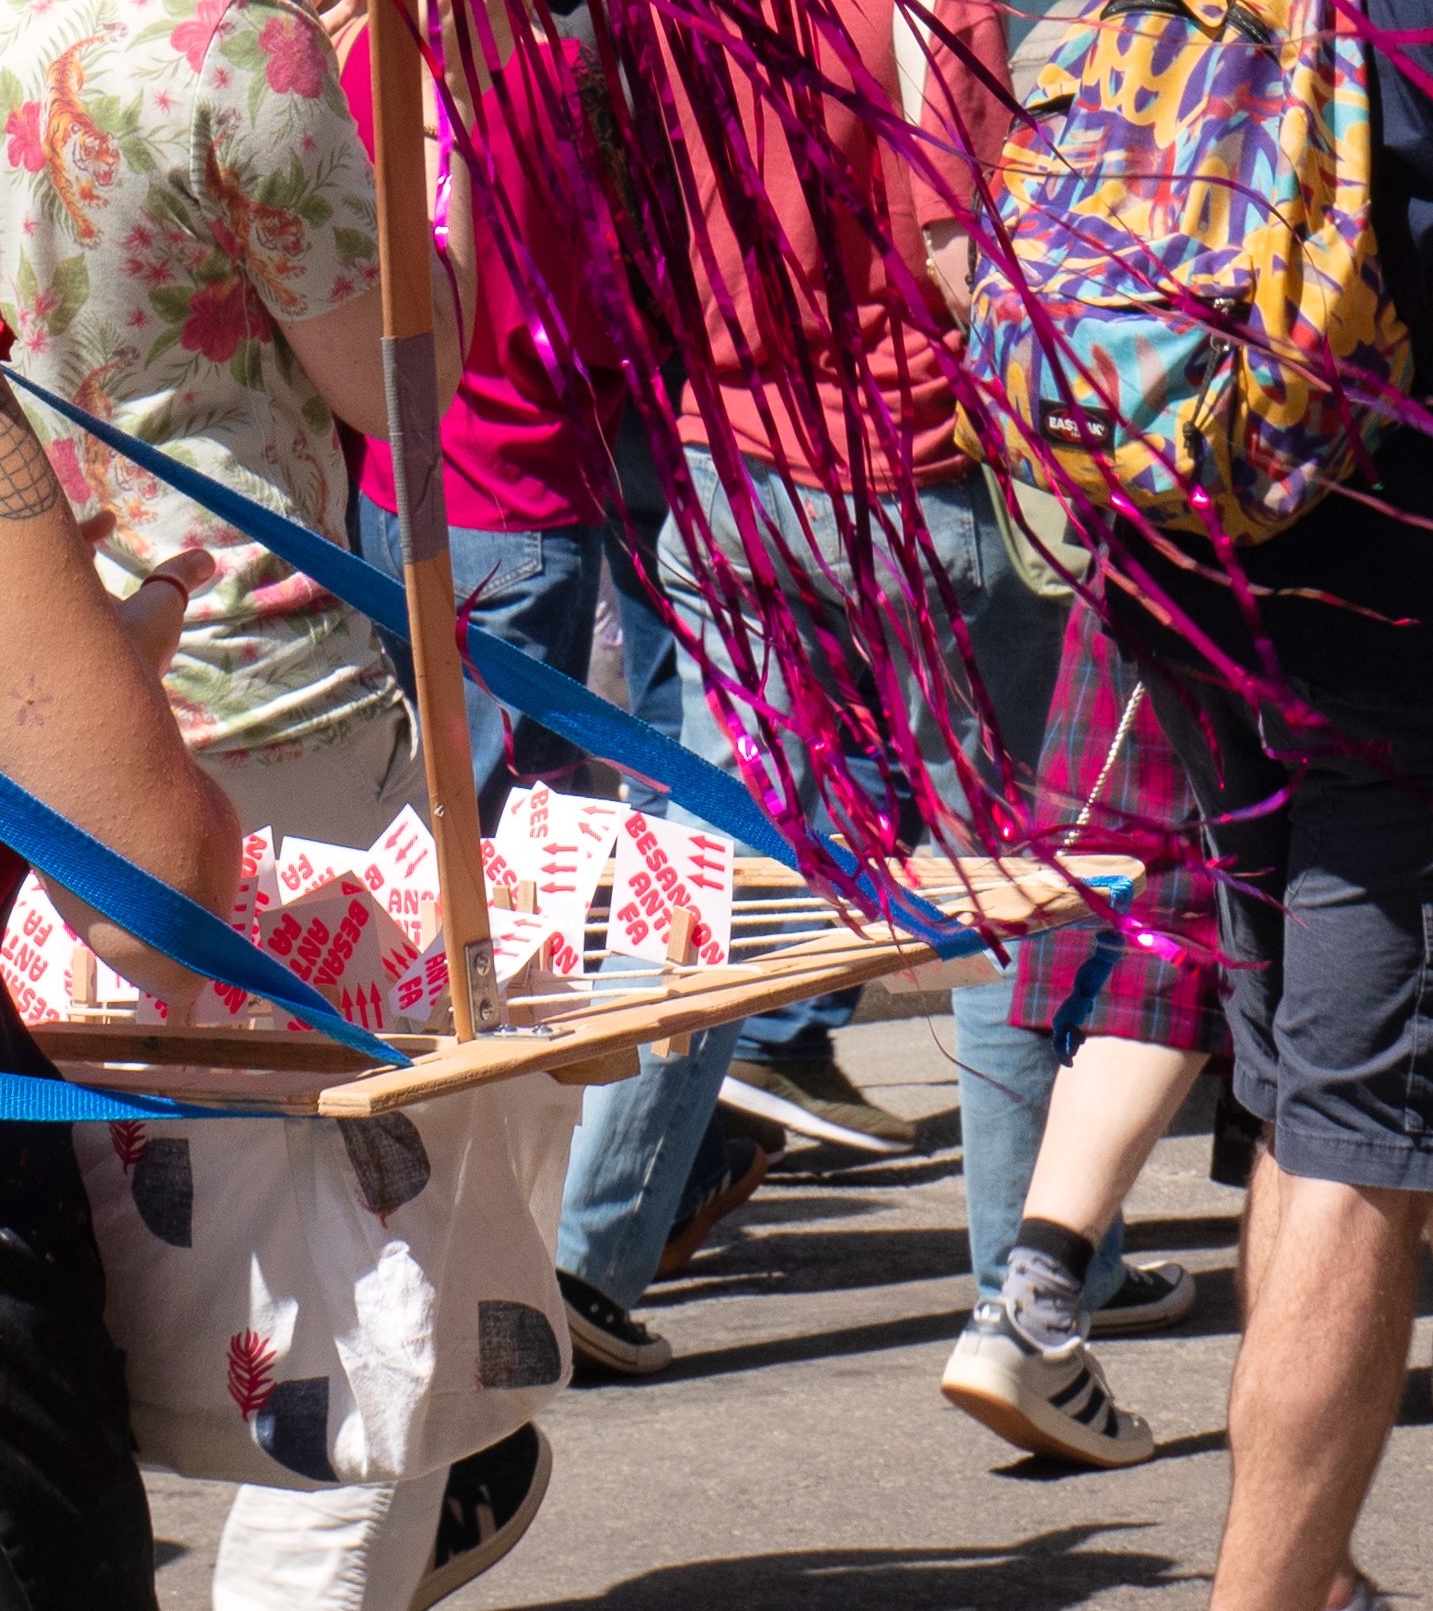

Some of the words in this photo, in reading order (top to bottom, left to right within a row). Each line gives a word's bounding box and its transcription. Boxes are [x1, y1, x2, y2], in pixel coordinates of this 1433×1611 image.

[23, 909, 53, 947] FA
[617, 901, 649, 946] FA
[628, 871, 673, 945] ANT
[1, 929, 48, 982] ANT
[267, 913, 302, 956] FA
[290, 917, 329, 981] ANT
[398, 976, 424, 1010] FA
